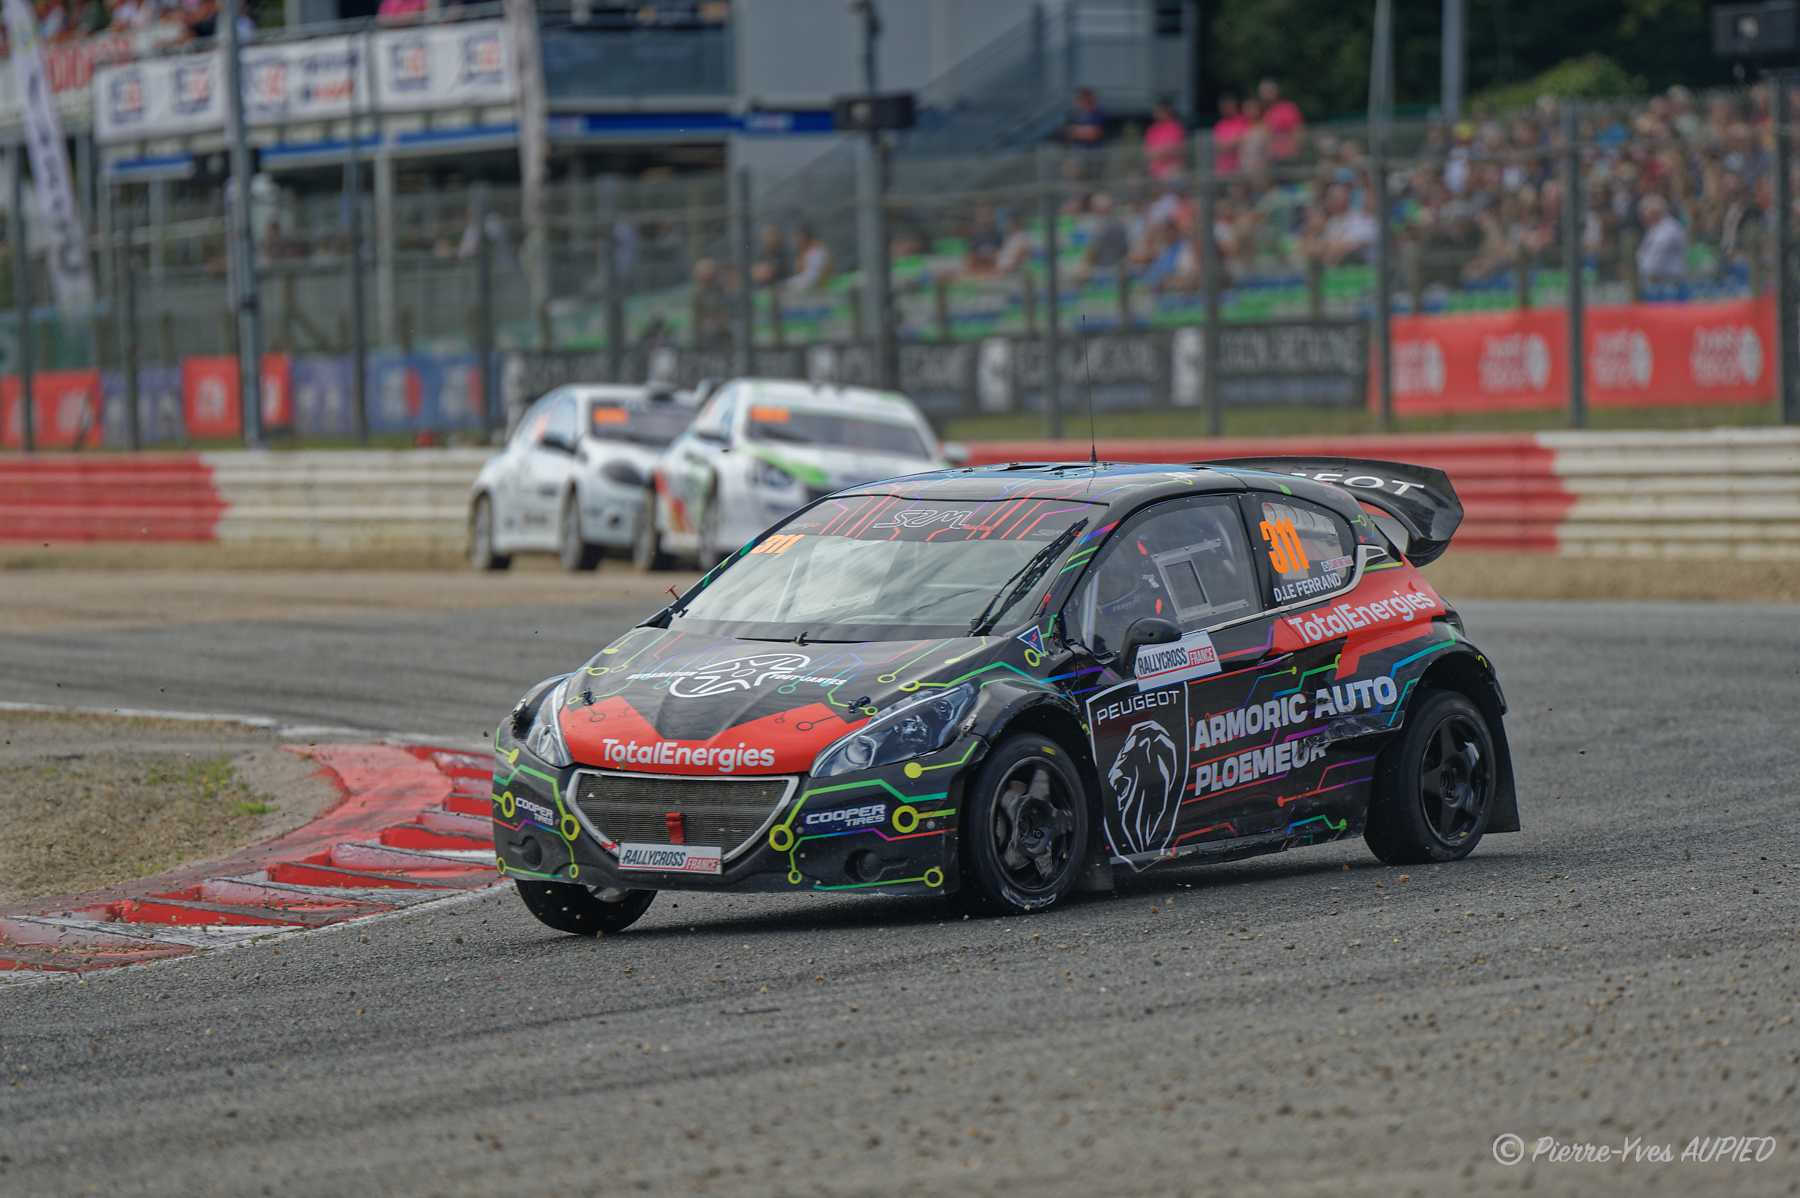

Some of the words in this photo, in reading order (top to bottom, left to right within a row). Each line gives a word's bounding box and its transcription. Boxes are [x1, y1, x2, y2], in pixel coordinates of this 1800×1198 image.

[1290, 472, 1425, 496] EOT
[1259, 516, 1310, 574] 311
[1296, 573, 1342, 598] FERRAND
[1288, 590, 1437, 644] TotalEnergies
[1137, 647, 1188, 675] RALLYCROSS
[1188, 646, 1216, 666] FRANCE
[1096, 689, 1180, 726] PEUGEOT
[1194, 692, 1309, 751] ARMORIC
[1313, 675, 1399, 719] AUTO
[602, 738, 776, 772] TotalEnergies
[514, 797, 554, 819] COOPER
[804, 804, 887, 826] COOPER
[844, 814, 886, 828] TIRES
[623, 848, 687, 867] RALLYCROSS
[686, 857, 721, 873] FRANCE
